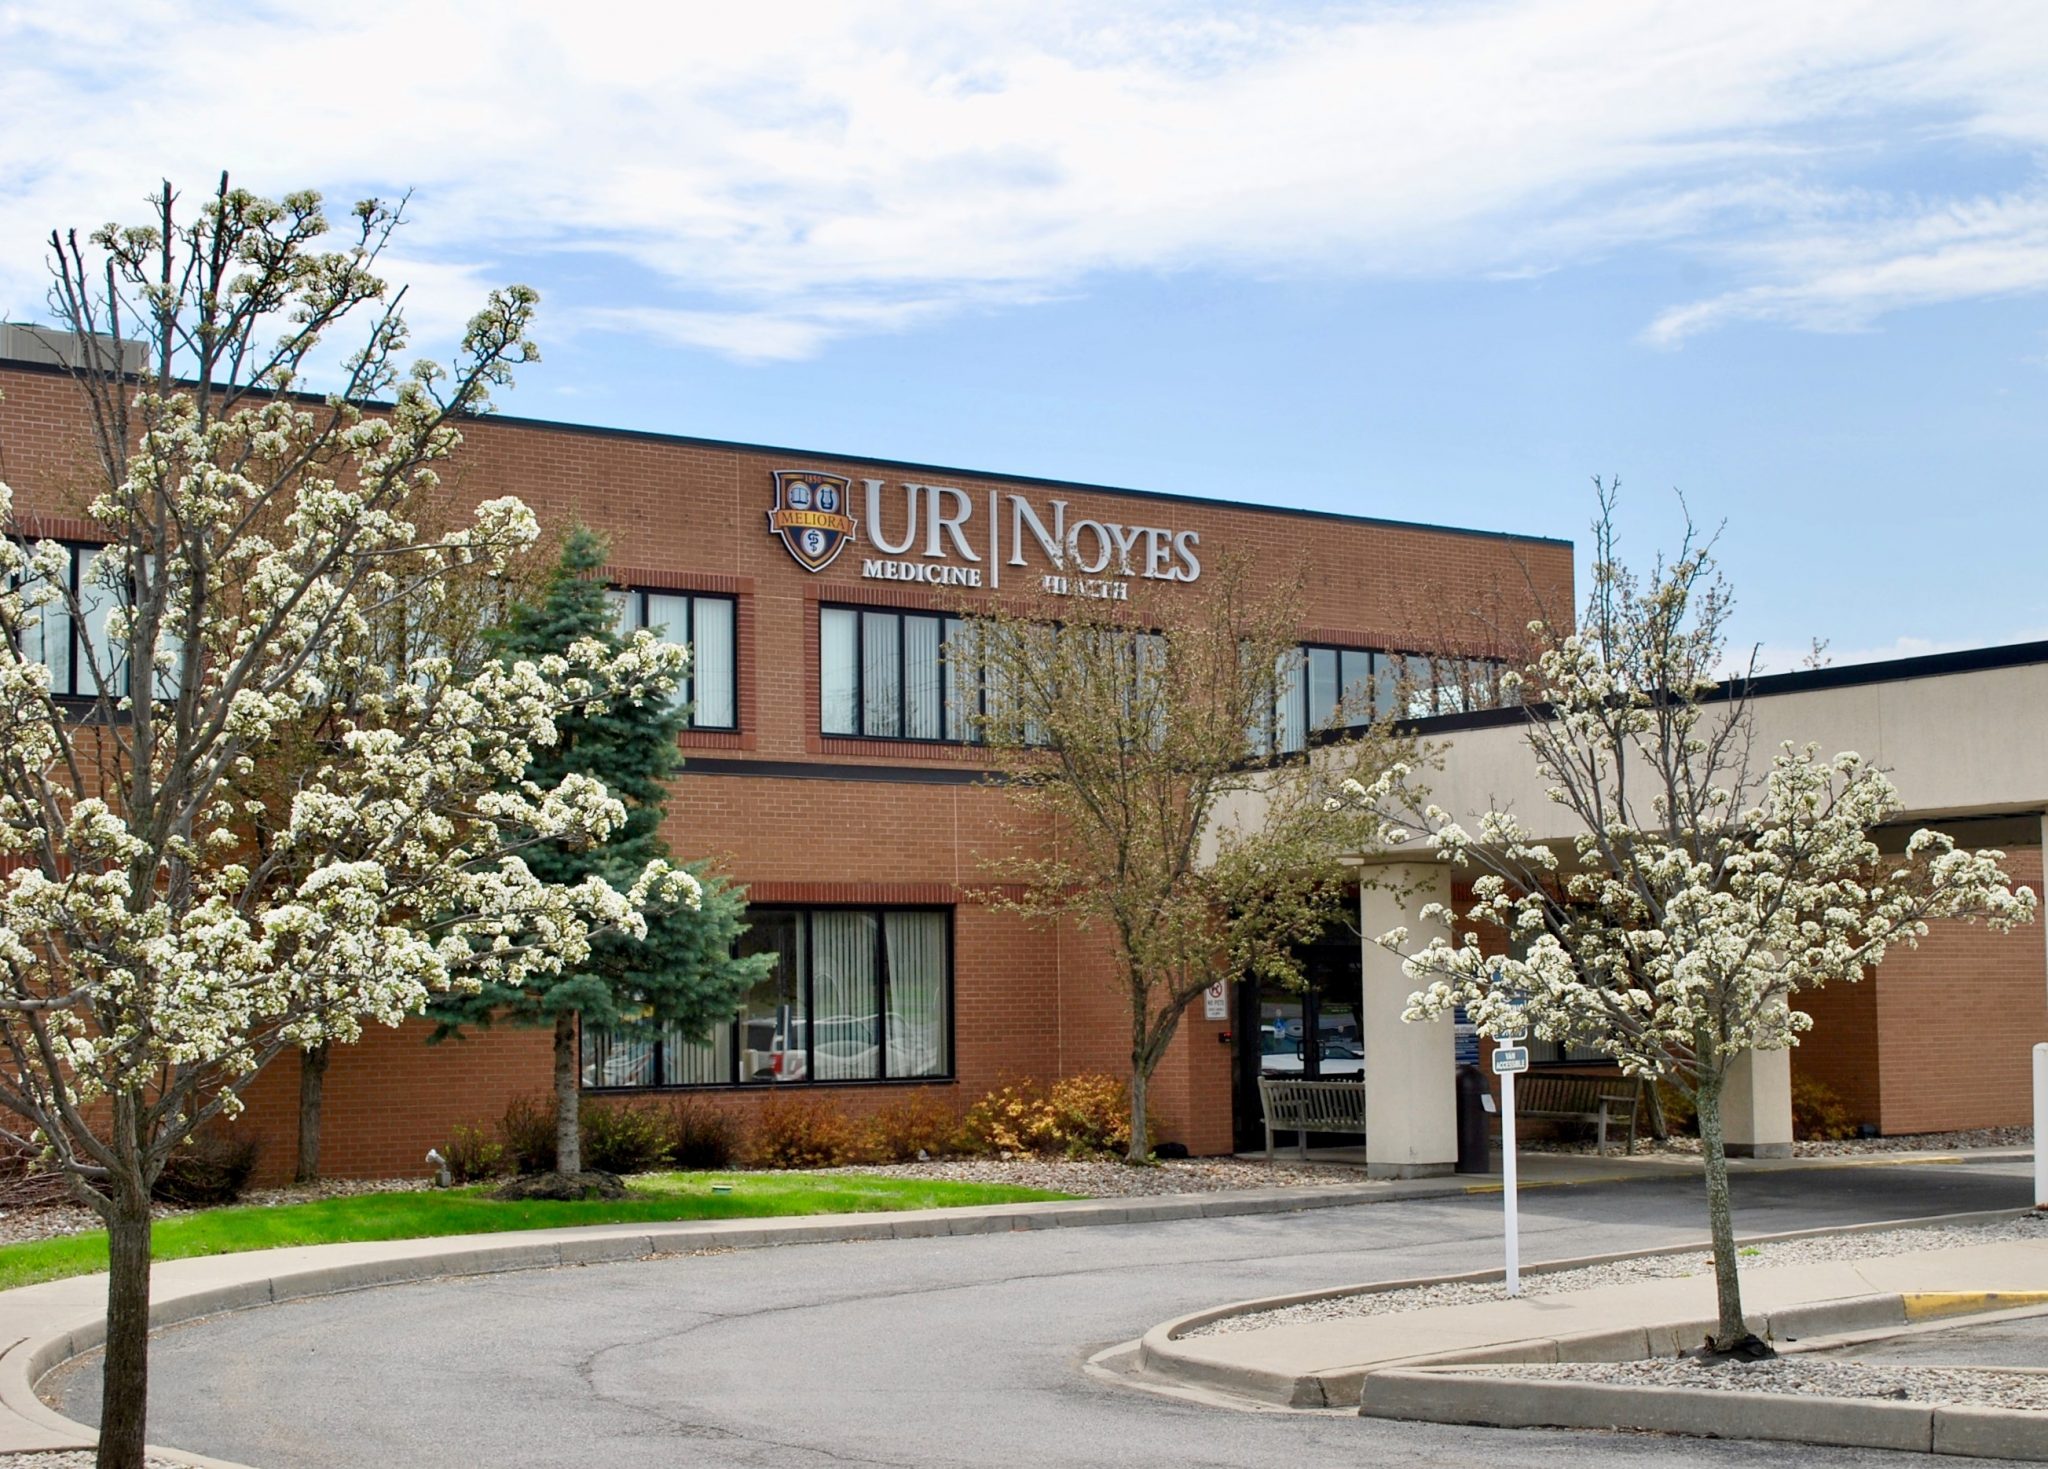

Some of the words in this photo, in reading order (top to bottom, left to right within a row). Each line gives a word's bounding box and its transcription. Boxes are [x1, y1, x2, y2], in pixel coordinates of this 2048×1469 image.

[782, 512, 845, 529] MELIORA
[861, 479, 982, 561] UR
[1007, 494, 1200, 582] NOYES
[862, 559, 982, 587] MEDICINE
